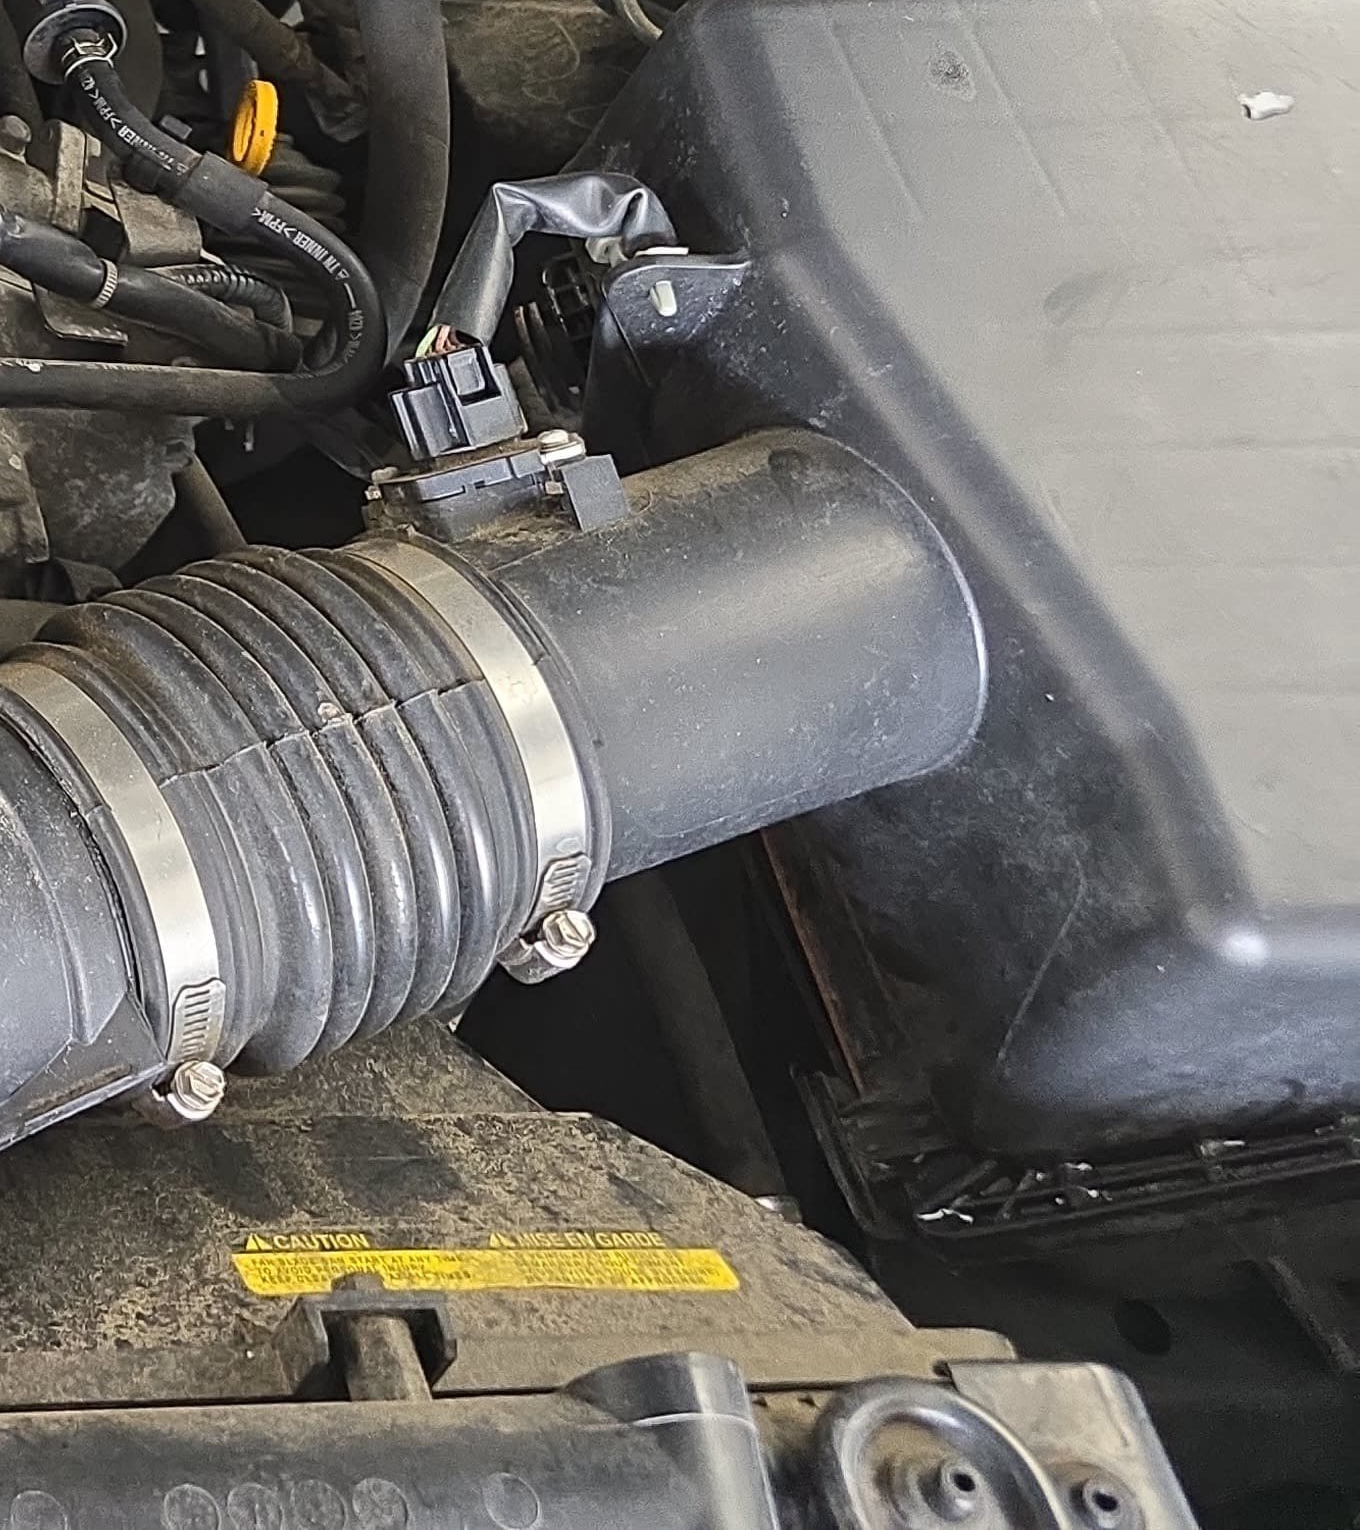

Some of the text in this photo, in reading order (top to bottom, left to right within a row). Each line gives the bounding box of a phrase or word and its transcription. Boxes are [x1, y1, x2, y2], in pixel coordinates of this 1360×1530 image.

[292, 231, 330, 262] INNER
[273, 1233, 371, 1251] CAUTION
[517, 1231, 667, 1248] MISE EN GARDE
[349, 1256, 388, 1265] START
[276, 1266, 312, 1276] AVOID
